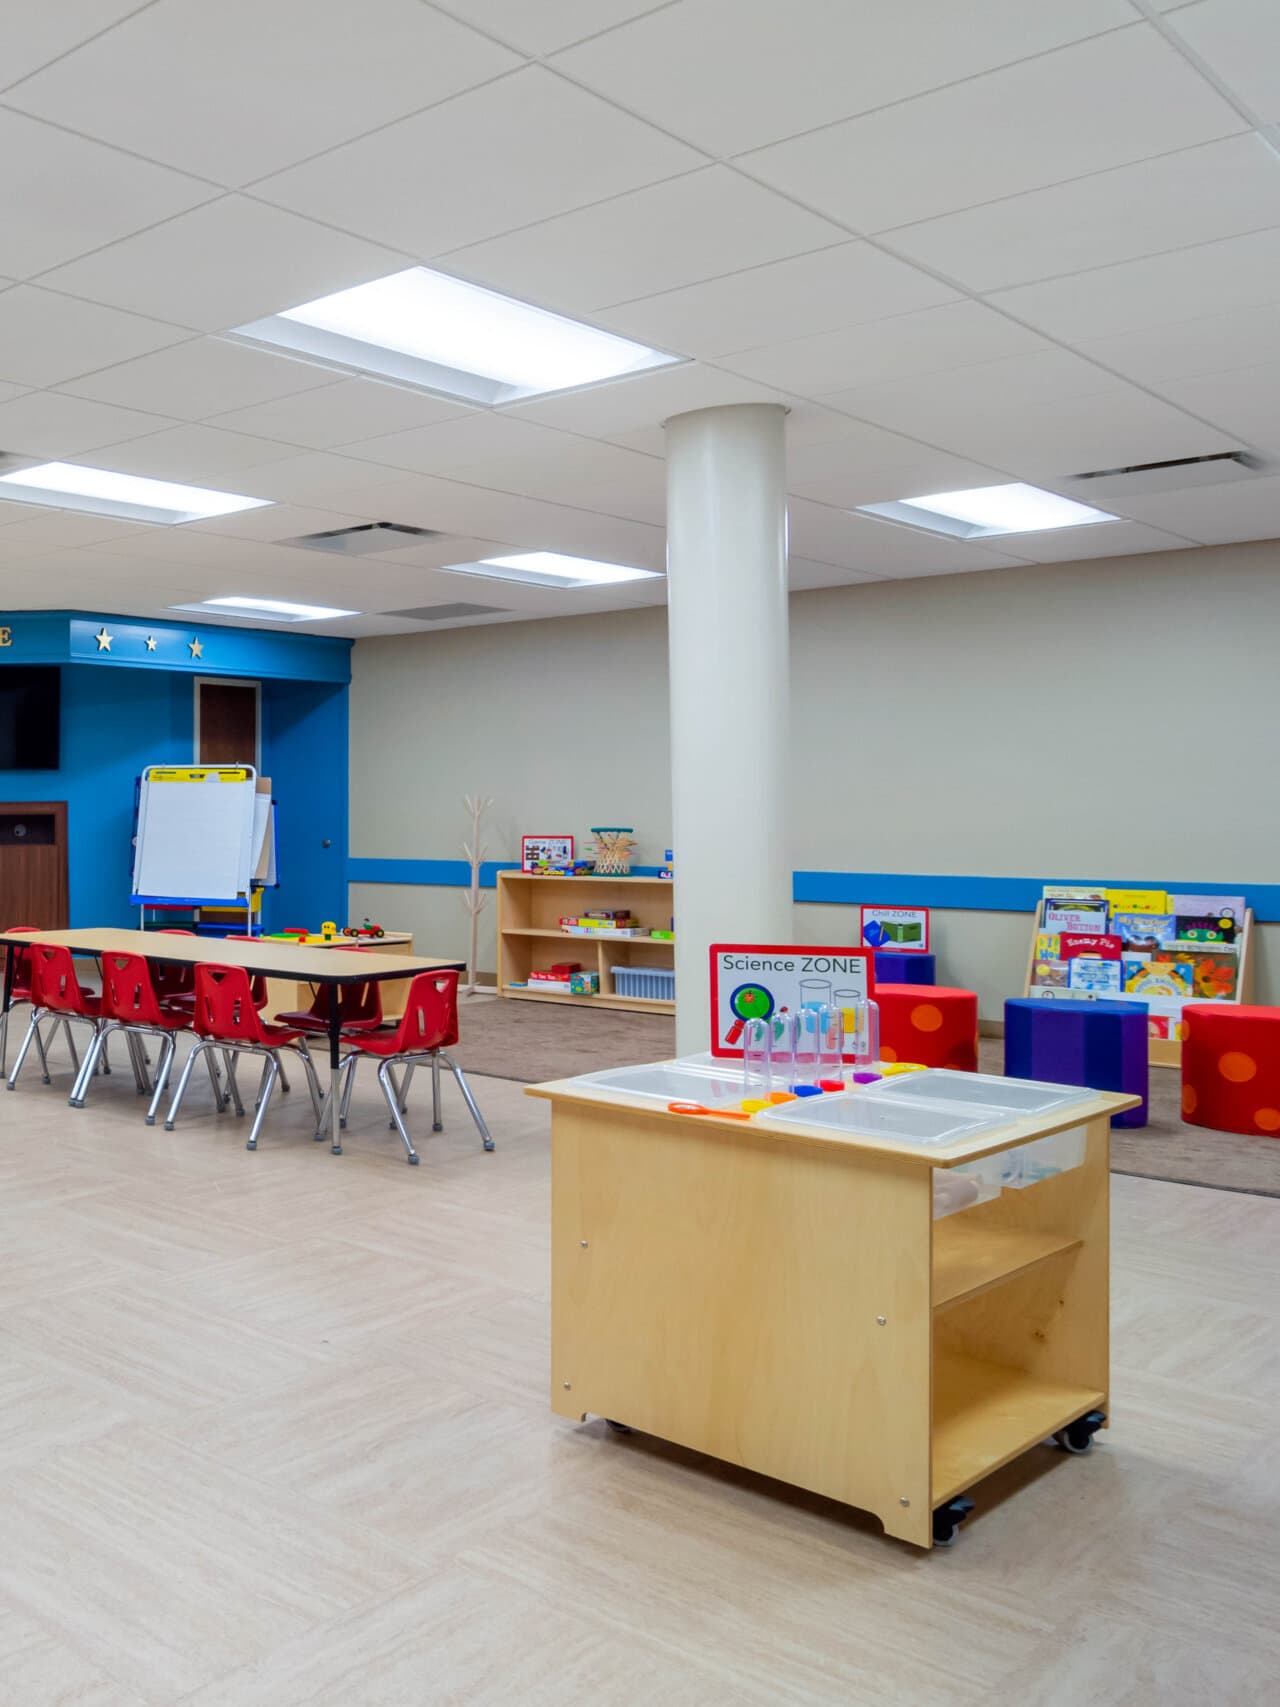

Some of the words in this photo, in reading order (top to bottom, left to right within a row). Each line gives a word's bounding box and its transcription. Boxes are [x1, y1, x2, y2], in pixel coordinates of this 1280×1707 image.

[891, 910, 917, 918] ZONE
[1066, 937, 1098, 947] Enemy
[1100, 938, 1115, 948] Pie
[723, 955, 795, 972] Science
[801, 957, 861, 974] ZONE
